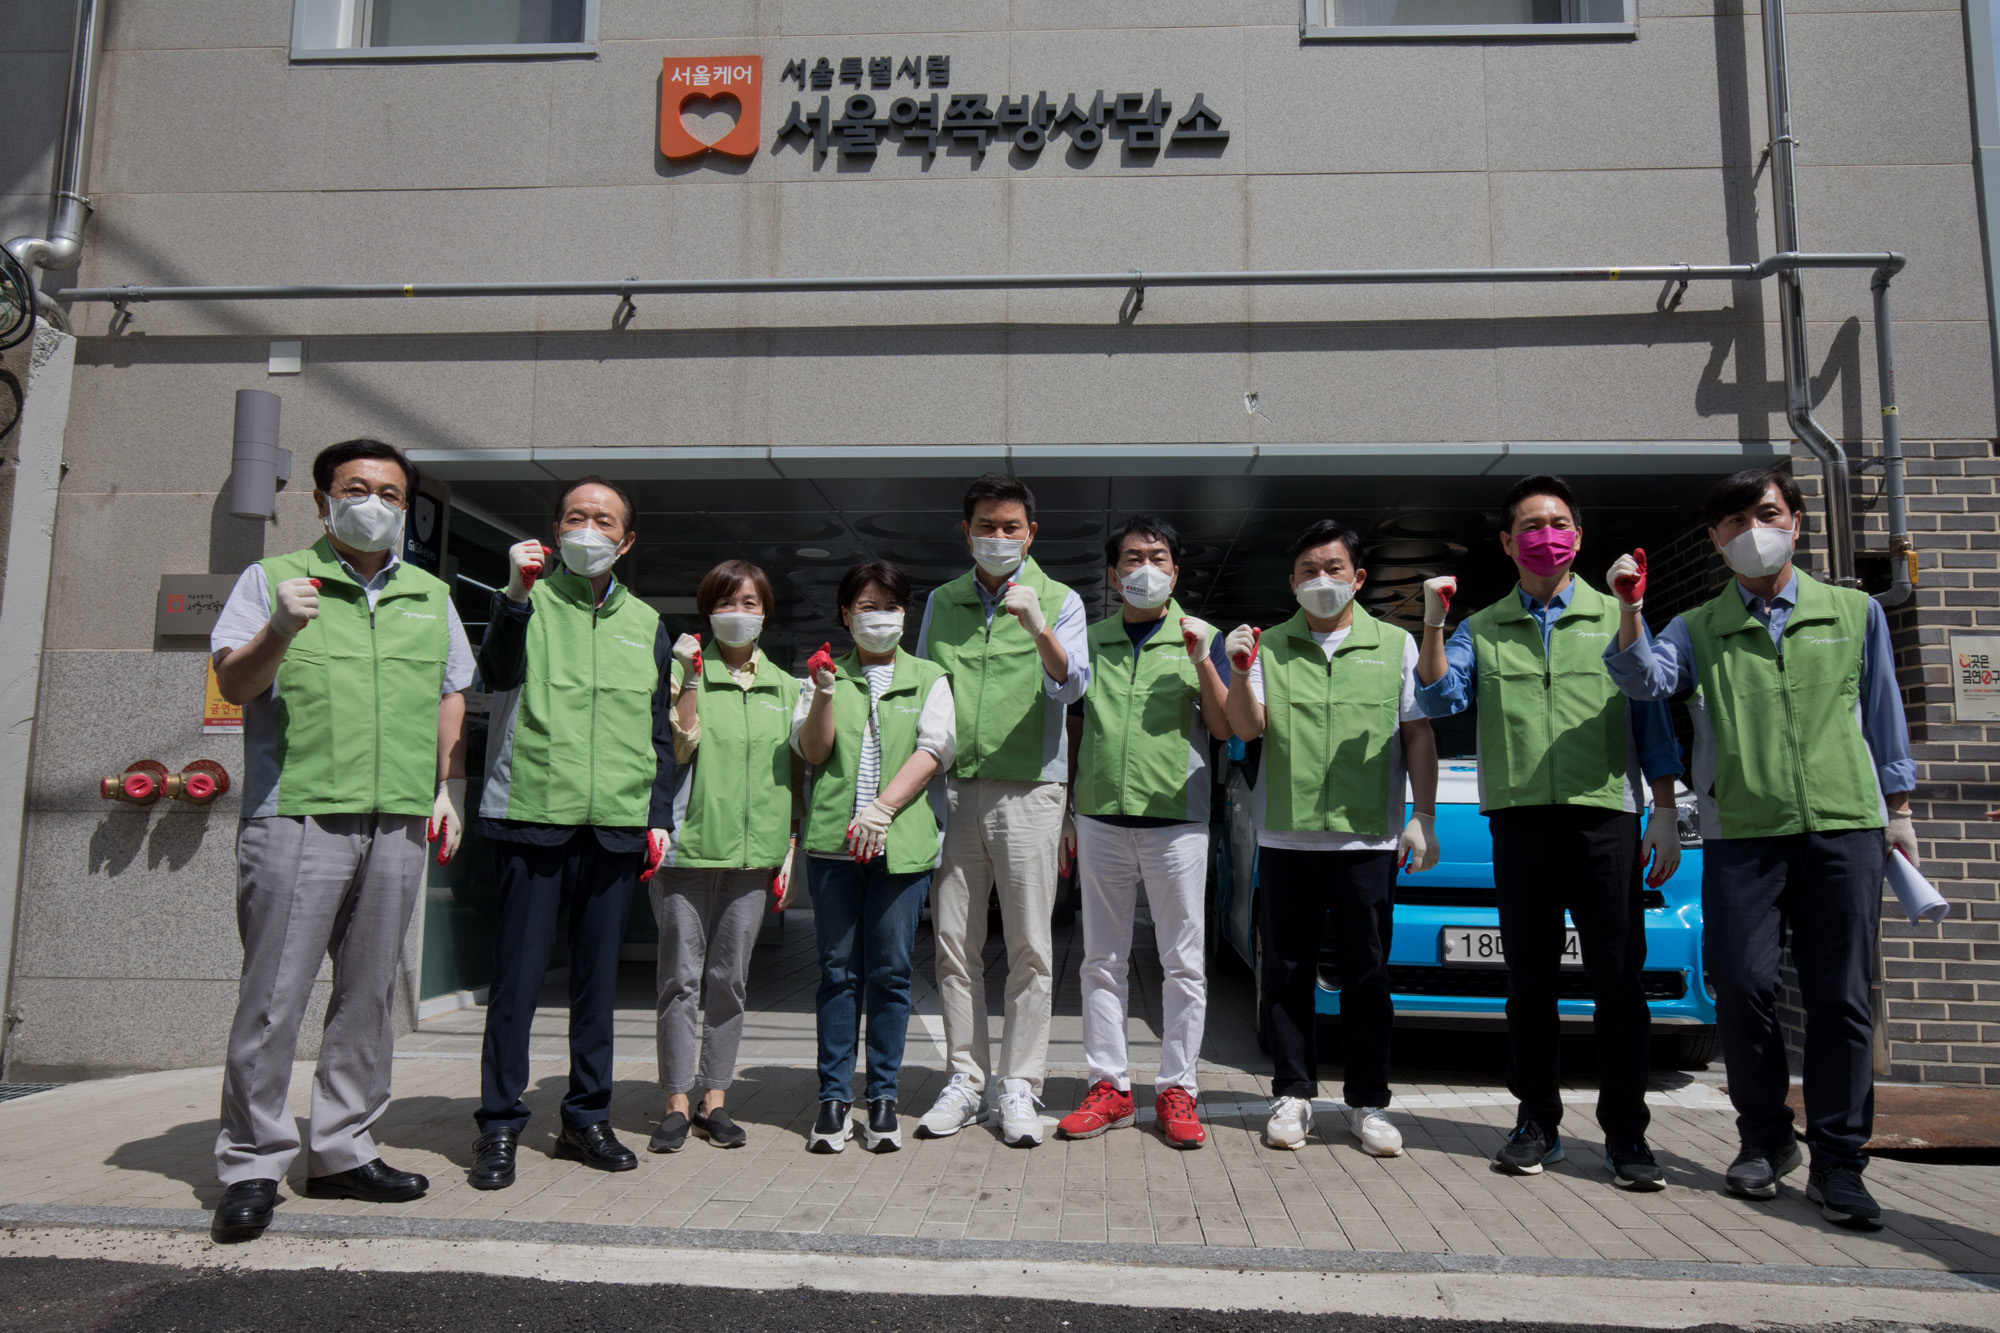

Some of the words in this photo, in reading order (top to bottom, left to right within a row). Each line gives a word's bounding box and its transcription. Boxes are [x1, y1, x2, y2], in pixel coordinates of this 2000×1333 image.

[671, 65, 752, 86] 서울케어
[780, 55, 950, 88] 서울특별시립
[777, 88, 1230, 157] 서울역쪽방상담소
[1962, 670, 2000, 685] 금연구
[210, 703, 242, 715] 금연구
